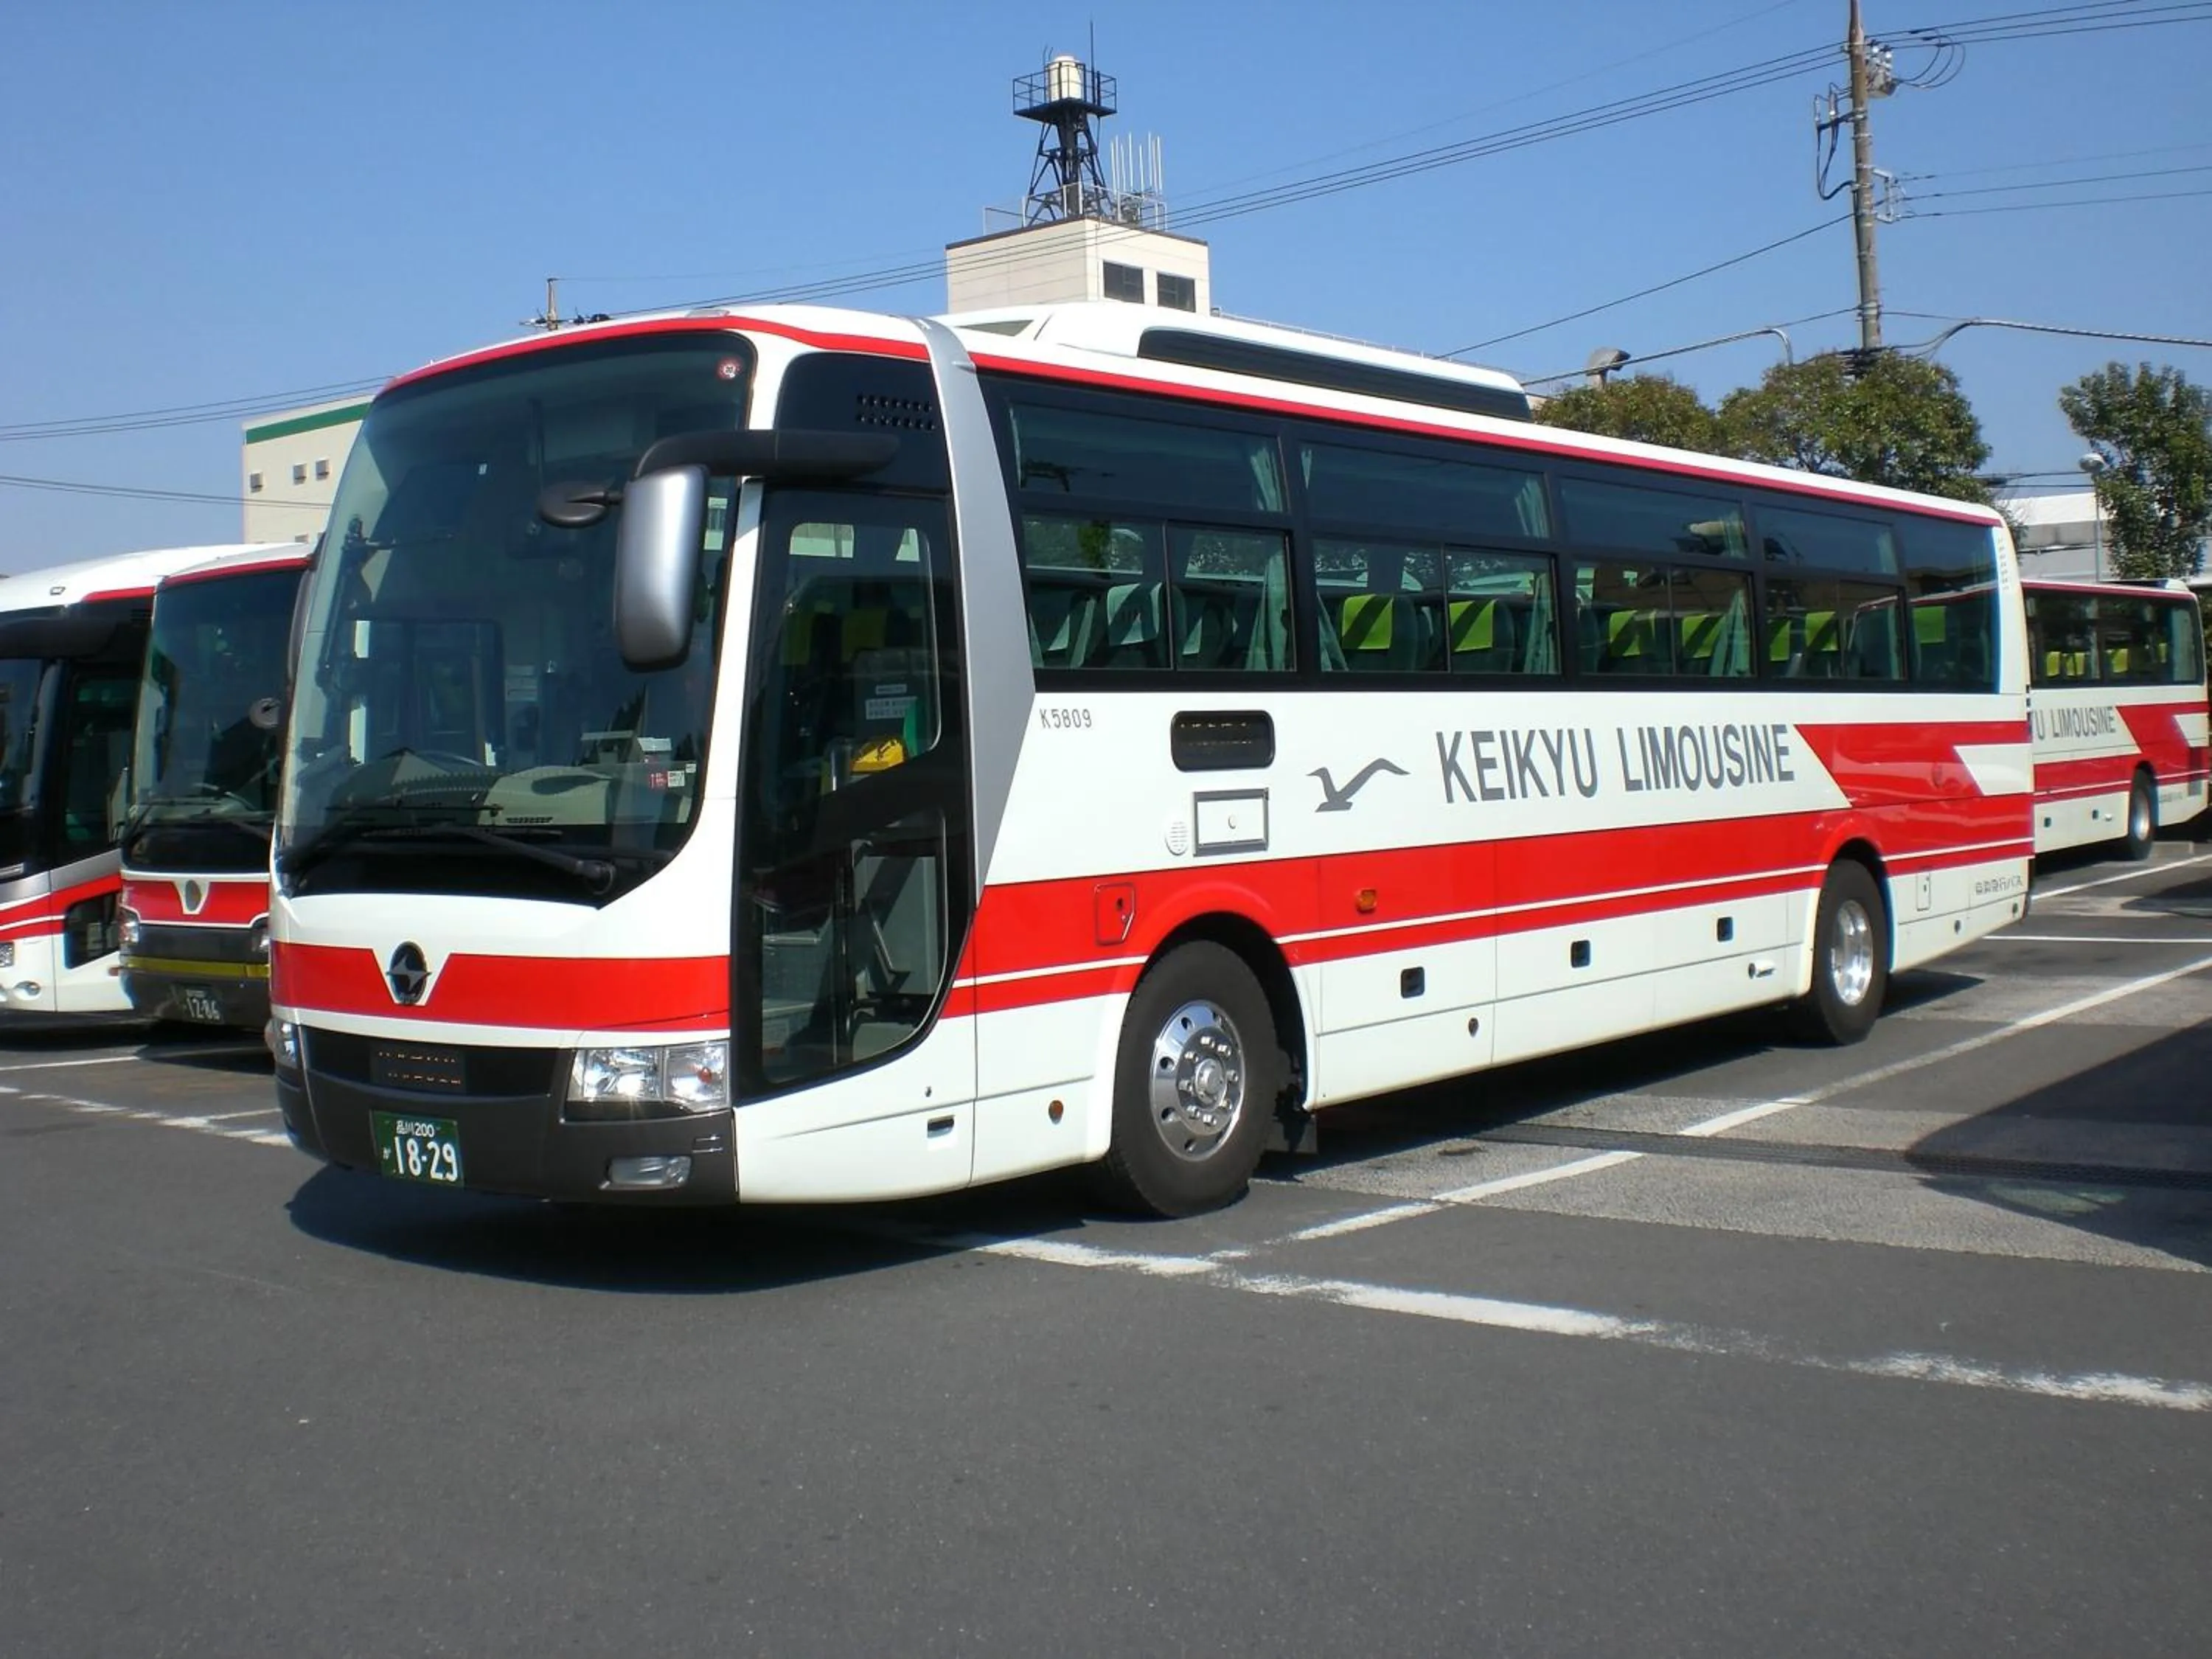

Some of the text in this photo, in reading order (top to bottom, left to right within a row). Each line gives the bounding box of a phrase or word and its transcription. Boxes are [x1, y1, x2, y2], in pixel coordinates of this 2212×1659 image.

[1039, 708, 1092, 728] K5809
[2051, 706, 2115, 738] LIMOUSINE
[1436, 723, 1795, 804] KEIKYU LIMOUSINE
[394, 1136, 458, 1182] 18-29
